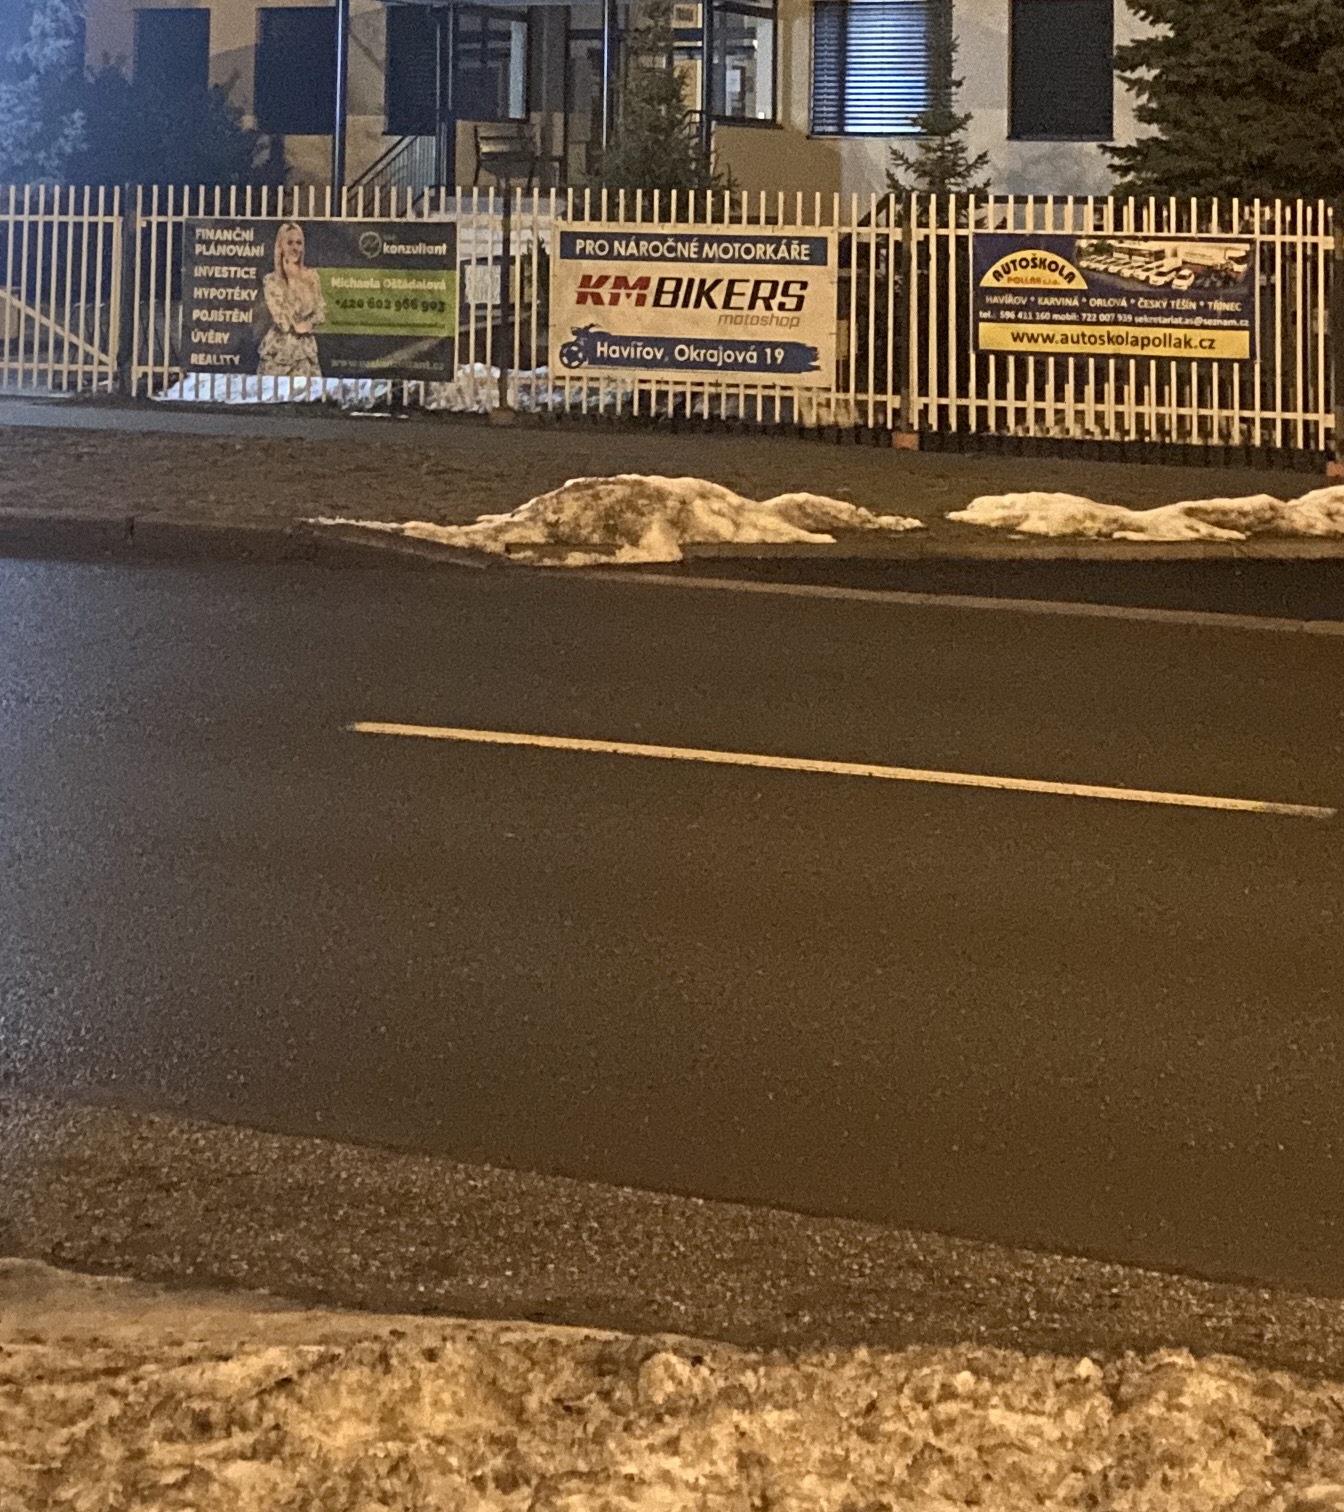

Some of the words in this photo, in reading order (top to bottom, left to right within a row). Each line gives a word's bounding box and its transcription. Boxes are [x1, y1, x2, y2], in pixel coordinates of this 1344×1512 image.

[195, 227, 254, 241] FINANČNÍ
[195, 242, 265, 257] PLÁNOVÁNÍ
[575, 239, 609, 256] PRO
[613, 236, 699, 259] NÁROČNÉ
[702, 239, 811, 261] MOTORKÁŘE
[194, 265, 257, 279] INVESTICE
[992, 253, 1077, 285] AUTOŠKOLA
[193, 286, 258, 300] HYPOTÉKY
[985, 293, 1028, 306] HAVÍŘOV
[1037, 295, 1080, 307] KARVINÁ
[1088, 296, 1128, 308] ORLOVÁ
[1137, 297, 1168, 309] ČESKÝ
[1170, 298, 1197, 310] TĚŠÍN
[1207, 299, 1243, 312] TŘINEC
[192, 308, 253, 323] POJIŠTĚNÍ
[717, 313, 801, 328] motoshop
[999, 310, 1016, 320] 596
[1017, 311, 1033, 320] 411
[1081, 313, 1097, 322] 722
[1098, 313, 1115, 322] 007
[191, 329, 230, 344] ÚVĚRY
[1011, 330, 1216, 351] www.autoskolapollak.cz
[190, 353, 240, 366] REALITY
[596, 341, 669, 362] Havířov,
[674, 344, 758, 367] Okrajová
[765, 348, 785, 364] 19
